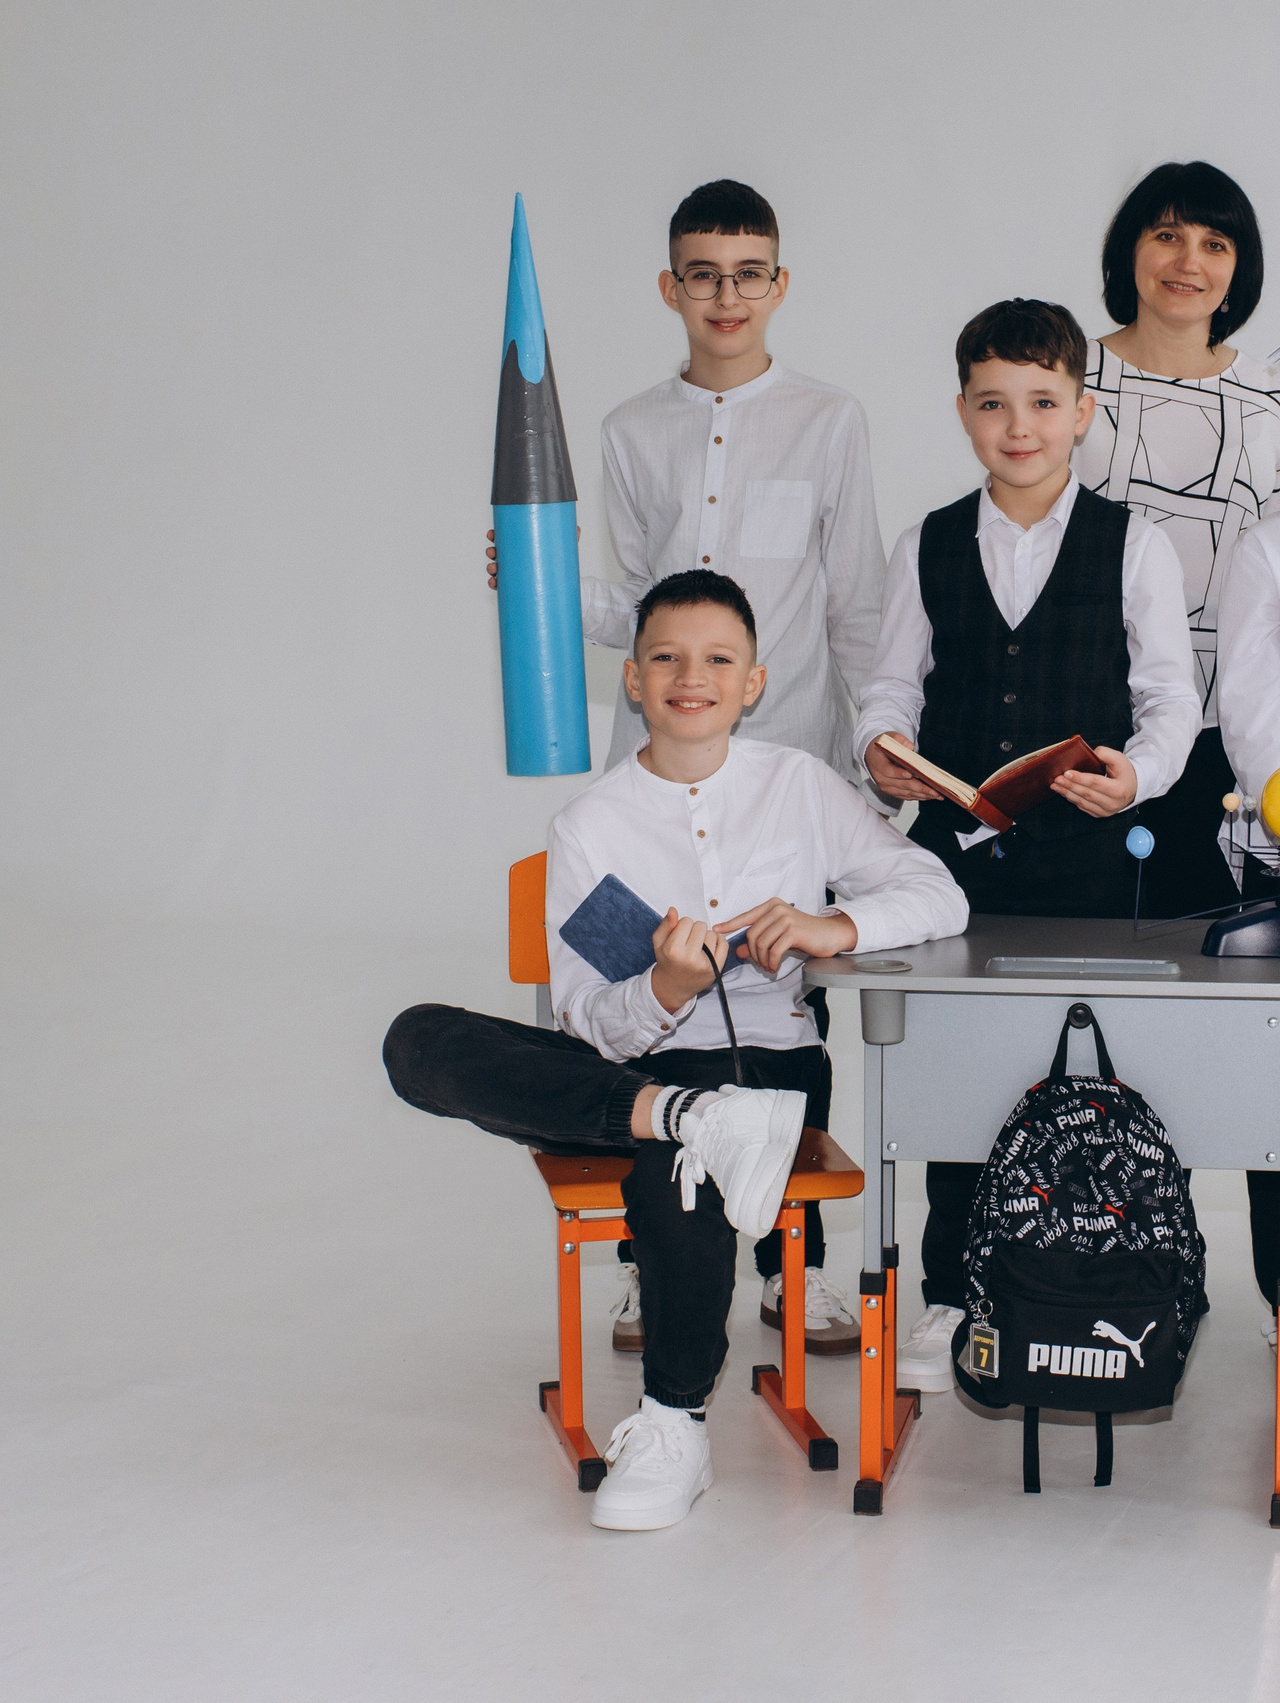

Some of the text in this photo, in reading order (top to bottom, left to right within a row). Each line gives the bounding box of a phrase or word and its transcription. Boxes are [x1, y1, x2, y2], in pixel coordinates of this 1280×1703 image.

[1072, 1081, 1120, 1095] PUMA
[1051, 1104, 1068, 1114] WE
[1129, 1119, 1143, 1134] WE
[1049, 1131, 1080, 1167] BRAVE
[1127, 1132, 1165, 1164] PUMA
[1099, 1150, 1117, 1171] PUMA
[1028, 1162, 1051, 1189] BRAVE
[989, 1180, 1001, 1218] BRAVE
[1100, 1180, 1124, 1208] BRAVE
[1003, 1196, 1039, 1213] UMA
[1073, 1202, 1089, 1213] WE
[1015, 1218, 1037, 1239] PUMA
[1072, 1215, 1117, 1232] PUMA
[1070, 1234, 1094, 1247] COOL
[1100, 1236, 1118, 1253] PUM
[1128, 1231, 1150, 1251] BRA
[980, 1347, 989, 1368] 7
[1028, 1342, 1127, 1379] PUMA
